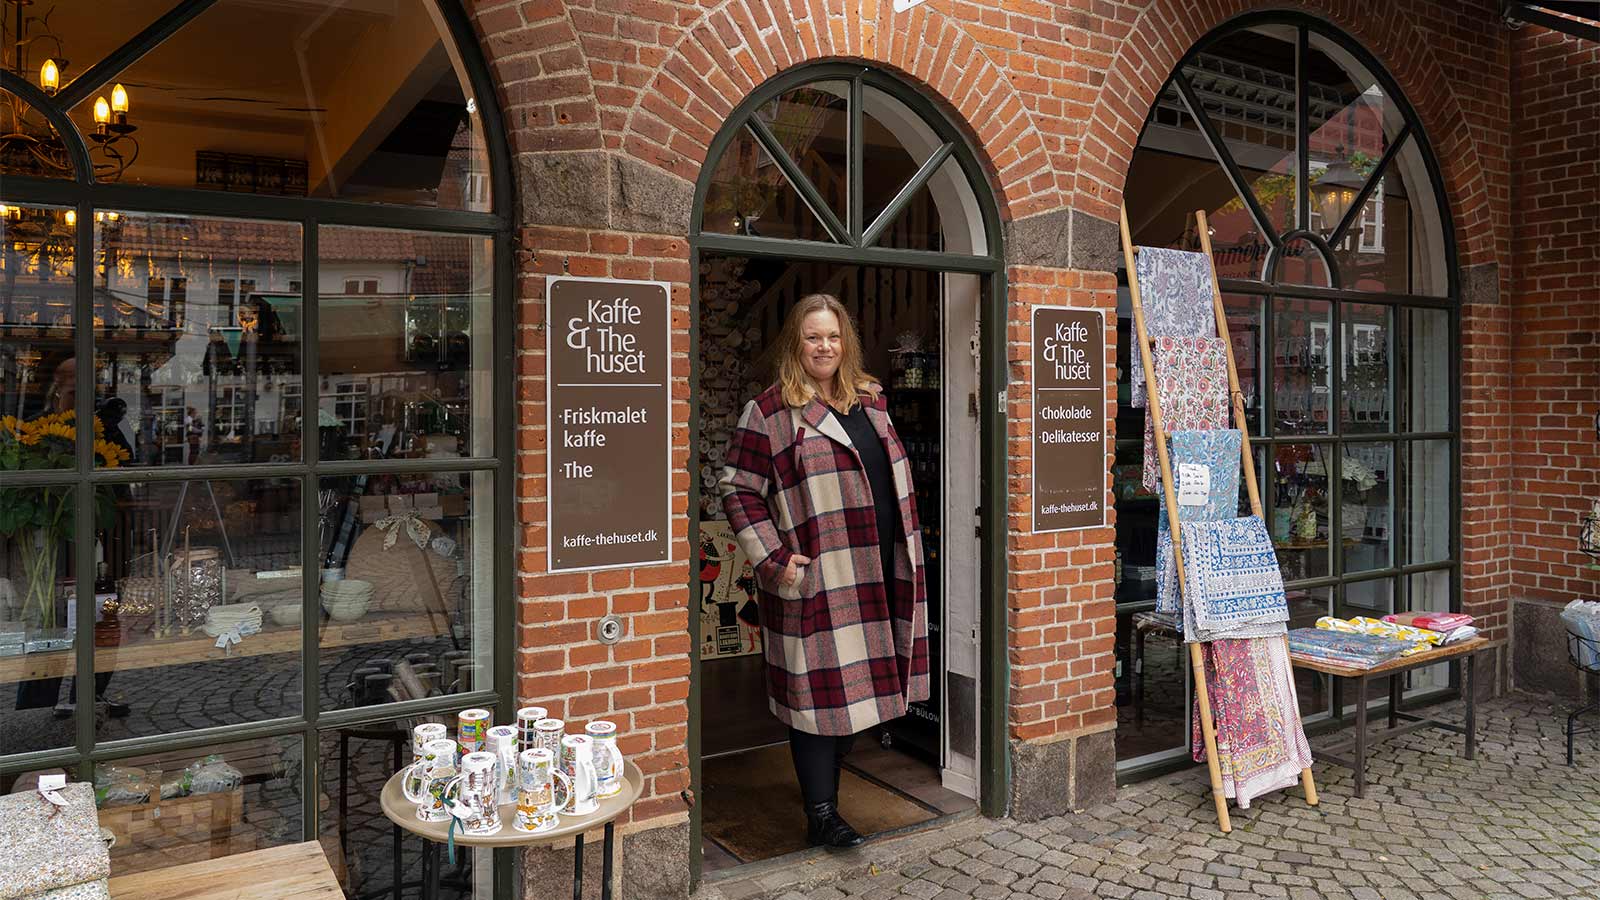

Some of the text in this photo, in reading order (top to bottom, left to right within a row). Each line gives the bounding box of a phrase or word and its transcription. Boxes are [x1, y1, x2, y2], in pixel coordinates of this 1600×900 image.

[588, 297, 641, 325] Kaffe
[566, 317, 636, 353] & The
[1055, 321, 1088, 342] Kaffe
[587, 346, 646, 373] huset
[1043, 336, 1085, 364] & The
[1055, 359, 1091, 380] huset
[563, 406, 647, 424] Friskmalet
[1041, 405, 1092, 419] Chokolade
[563, 429, 606, 447] kaffe
[1042, 429, 1100, 444] Delikatesser
[563, 461, 593, 478] The
[1041, 501, 1098, 515] kaffe-thehuset.dk
[563, 529, 657, 548] kaffe-thehuset.dk
